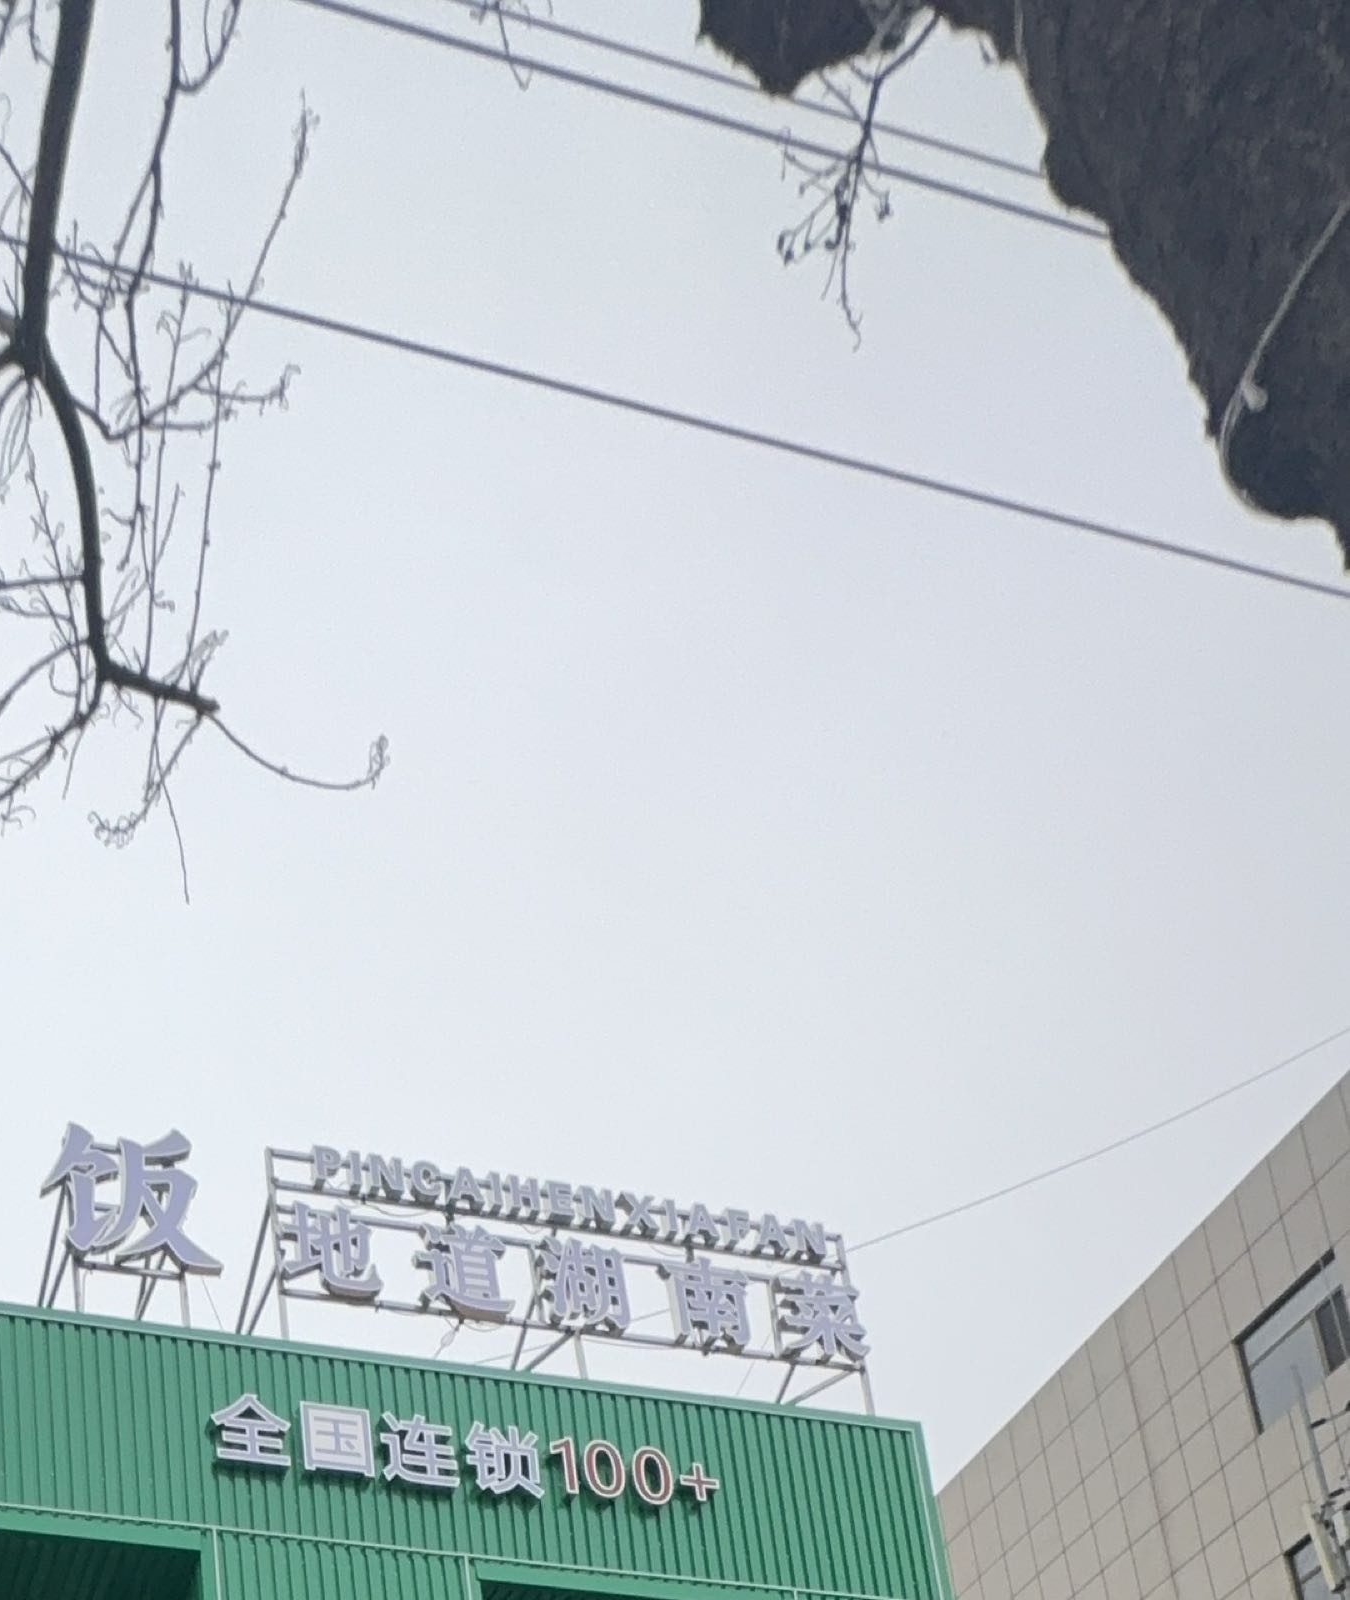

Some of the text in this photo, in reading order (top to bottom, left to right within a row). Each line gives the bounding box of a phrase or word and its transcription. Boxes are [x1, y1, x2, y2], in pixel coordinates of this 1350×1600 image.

[312, 1145, 827, 1264] PINCAIHENXIAFAN
[279, 1202, 871, 1364] 地道湖南菜
[210, 1392, 721, 1507] 全国连锁100+
